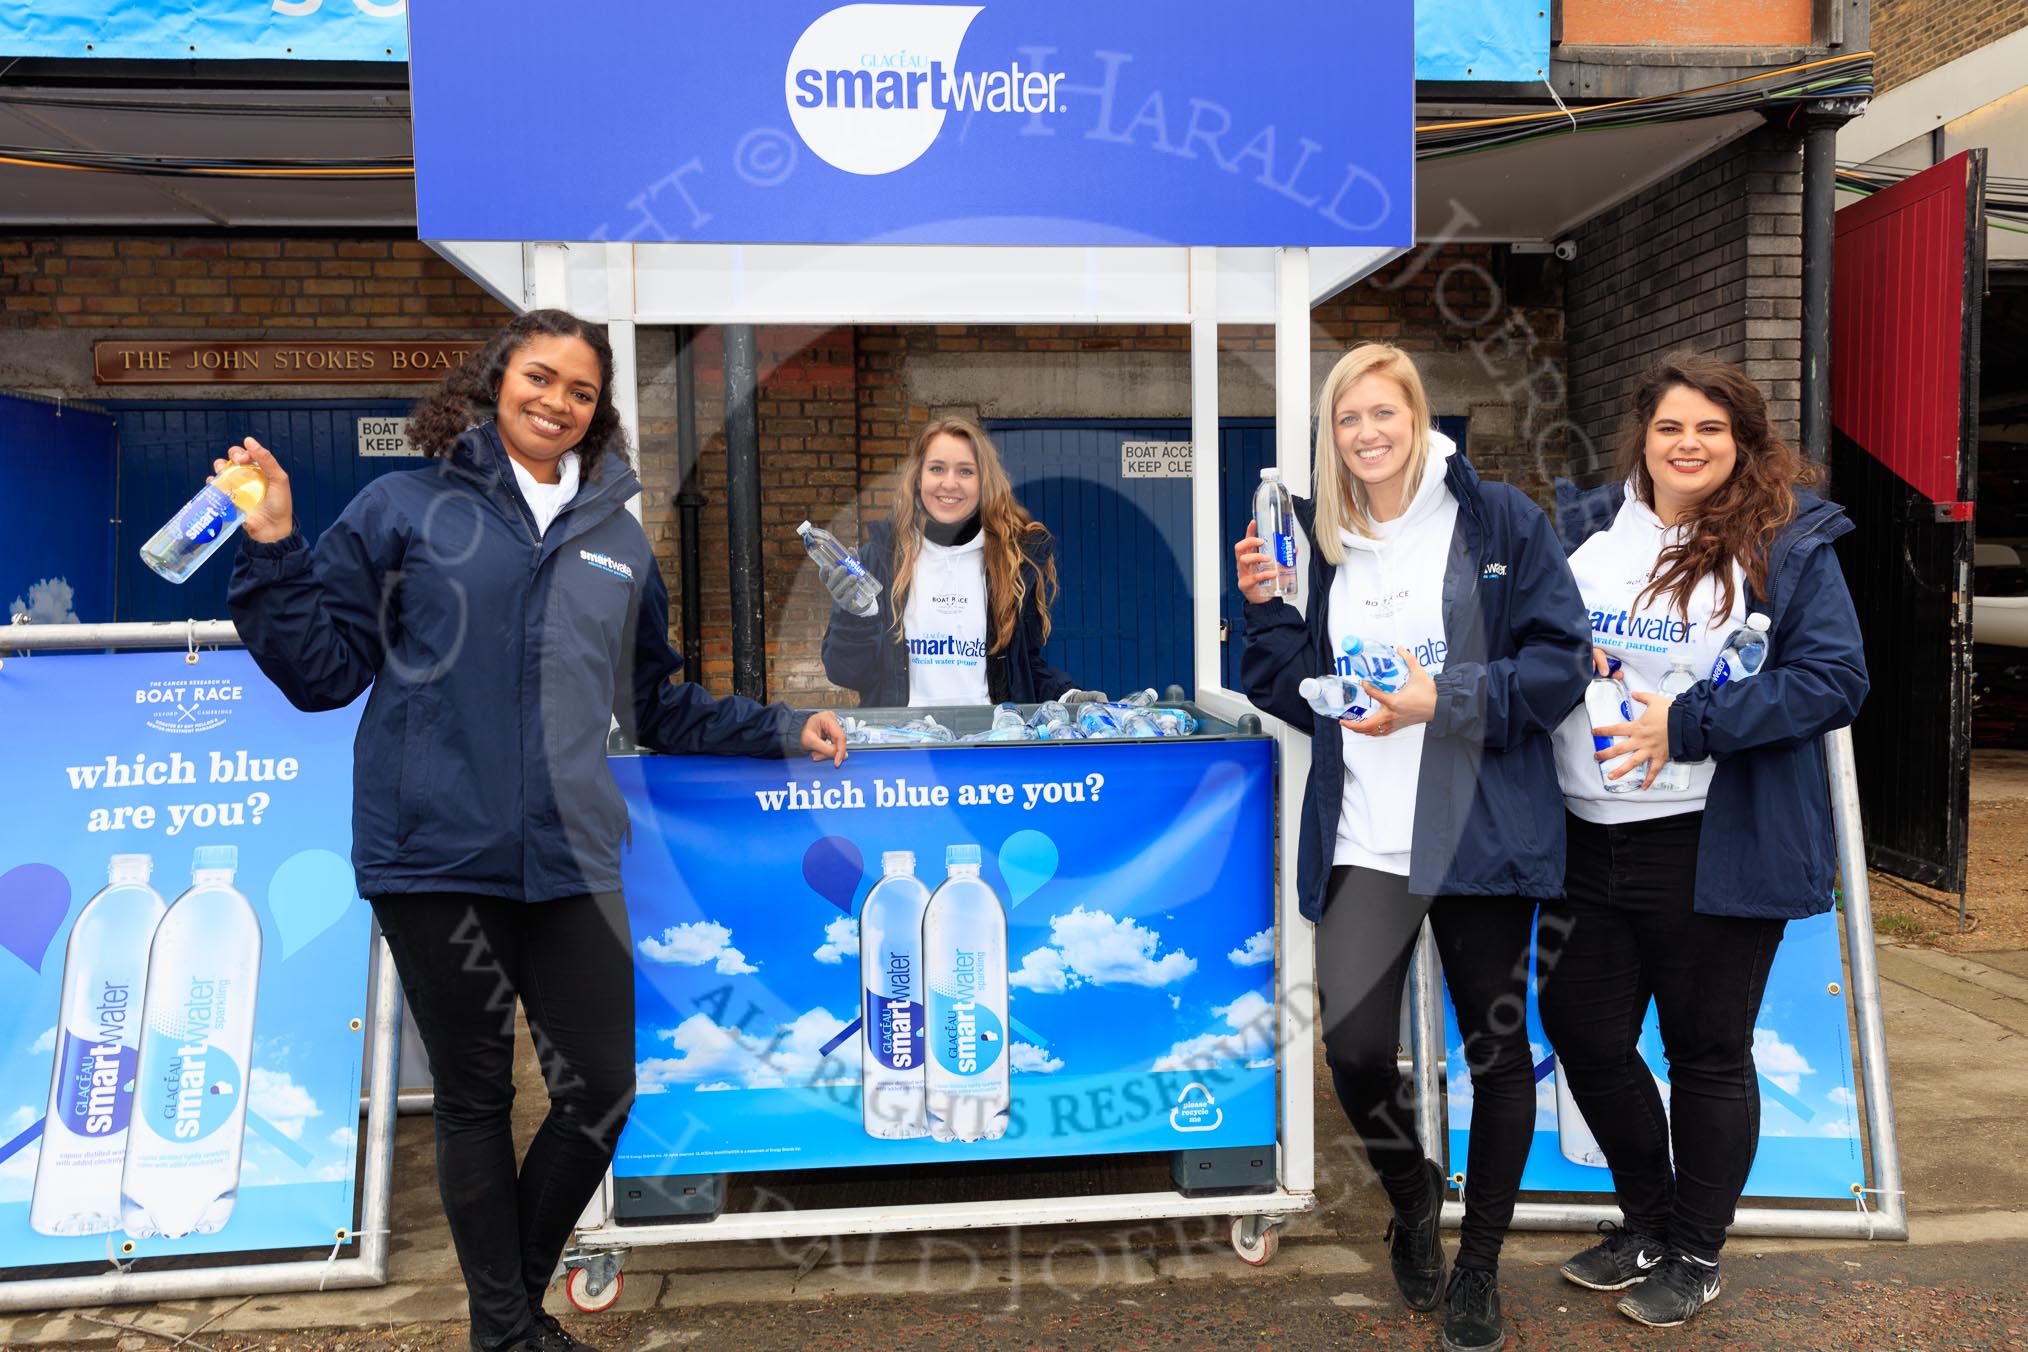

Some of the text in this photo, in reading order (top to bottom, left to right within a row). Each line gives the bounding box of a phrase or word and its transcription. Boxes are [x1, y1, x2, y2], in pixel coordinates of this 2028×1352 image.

[119, 351, 469, 371] THE JOHN STOKES BOAT
[363, 423, 399, 435] BOAT
[366, 439, 404, 451] KEEP
[1126, 447, 1158, 458] BOAT
[1128, 461, 1162, 473] KEEP
[1284, 535, 1294, 567] smart
[1585, 609, 1697, 644] artwater
[905, 635, 987, 658] smartwate
[135, 686, 242, 704] BOAT RACE
[66, 750, 299, 789] which blue
[755, 773, 1105, 811] which blue are you?
[87, 792, 271, 835] are you?
[215, 979, 231, 1030] sparkling
[887, 952, 912, 1067] smartwater
[952, 948, 977, 1073] smartwater
[86, 981, 129, 1133] smartwater
[175, 976, 215, 1138] smartwater
[1181, 1108, 1208, 1117] recycle
[1183, 1101, 1207, 1109] please
